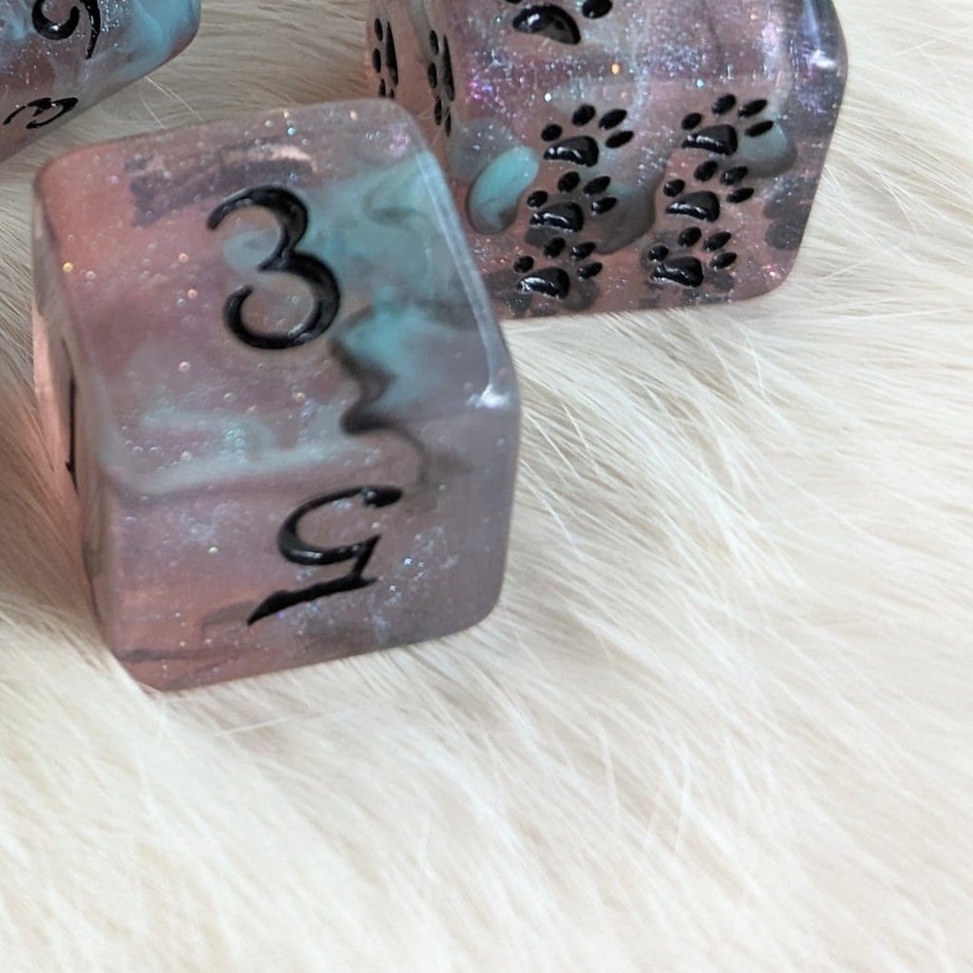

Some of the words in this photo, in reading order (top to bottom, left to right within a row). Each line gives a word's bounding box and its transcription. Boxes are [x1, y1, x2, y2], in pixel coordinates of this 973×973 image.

[2, 96, 80, 130] 3
[206, 184, 342, 351] 3
[245, 485, 404, 627] 5
